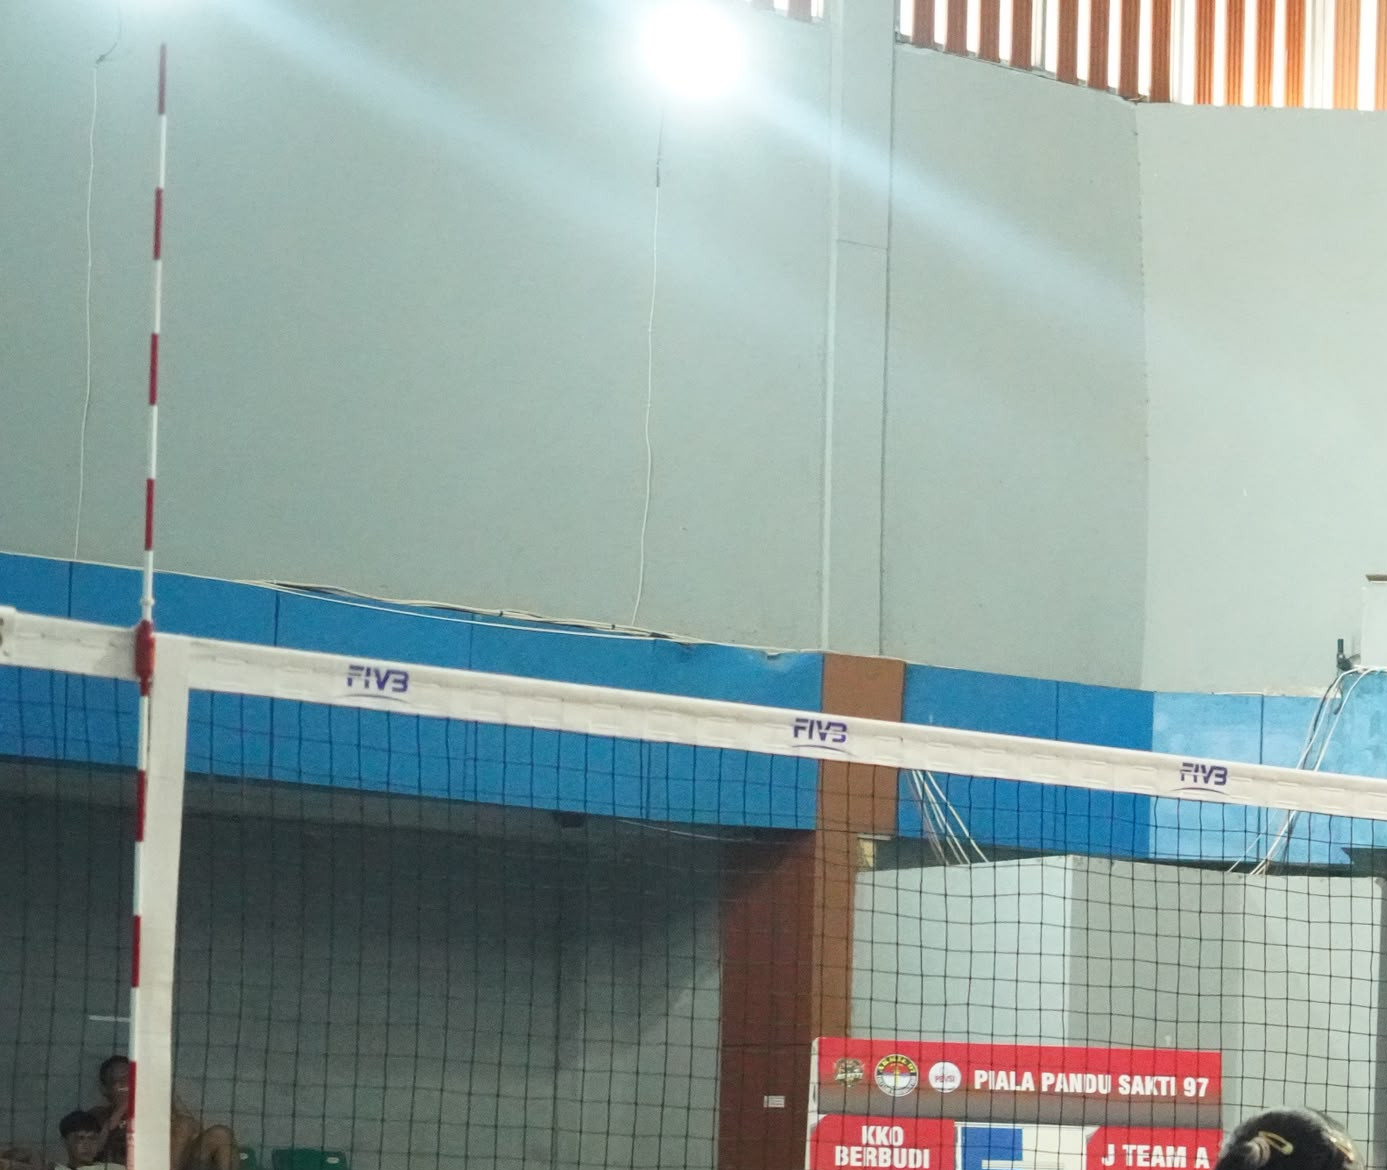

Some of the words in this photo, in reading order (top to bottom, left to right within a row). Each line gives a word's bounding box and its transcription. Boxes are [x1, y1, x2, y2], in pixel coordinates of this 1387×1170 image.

[347, 664, 409, 694] FIVB
[793, 717, 847, 743] FIVB
[1180, 762, 1228, 786] FIVB
[974, 1069, 1035, 1092] PIALA
[1042, 1072, 1111, 1095] PANDU
[1118, 1074, 1176, 1097] SAKTI
[1183, 1076, 1209, 1098] 97
[861, 1125, 904, 1147] KKO
[834, 1145, 931, 1169] BERBUDI
[1101, 1144, 1115, 1165] J
[1122, 1144, 1187, 1168] TEAM
[1194, 1145, 1210, 1169] A
